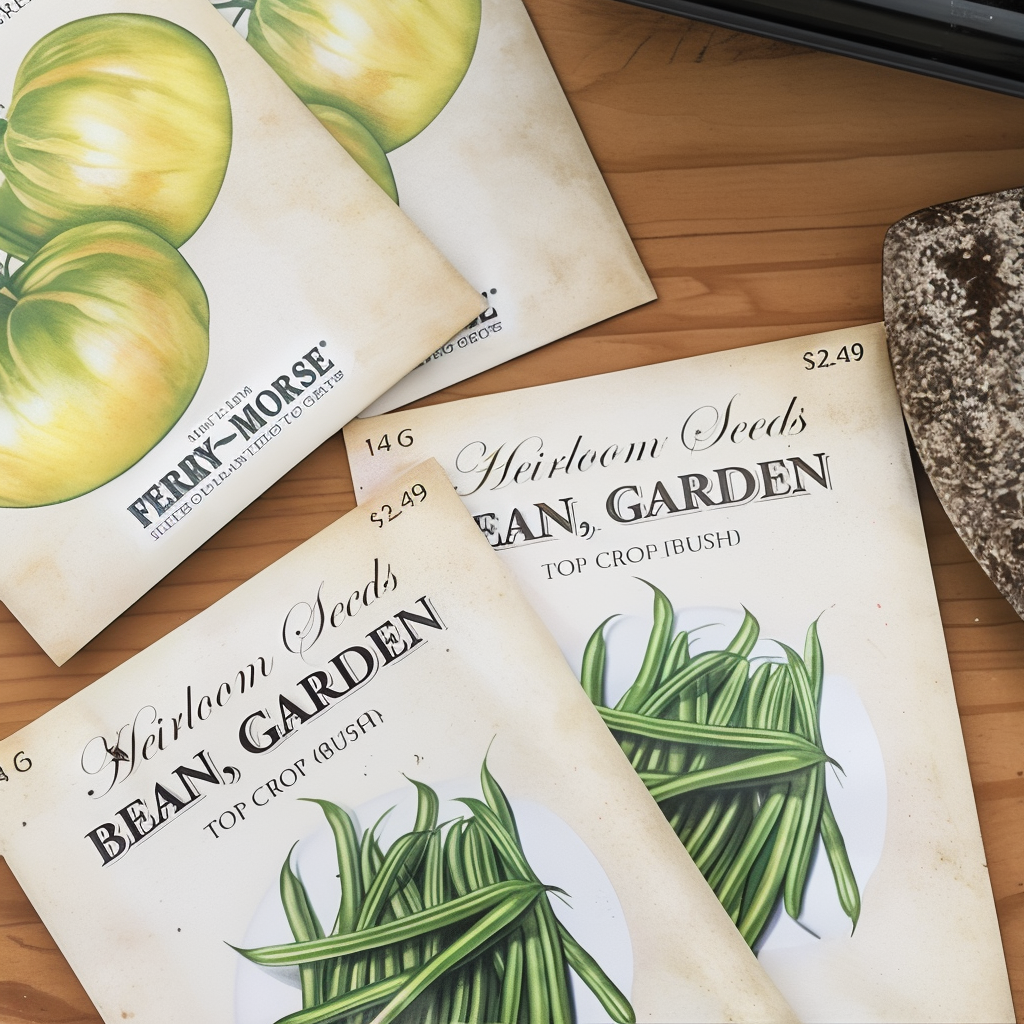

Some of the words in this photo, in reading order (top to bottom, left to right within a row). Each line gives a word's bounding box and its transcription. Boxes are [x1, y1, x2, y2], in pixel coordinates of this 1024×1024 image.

[453, 435, 668, 497] Heirloom
[681, 393, 807, 453] Seeds
[606, 452, 833, 524] GARDEN
[541, 557, 588, 580] TOP
[596, 544, 659, 570] CROP
[84, 749, 242, 868] BEAN,
[238, 595, 448, 755] GARDEN
[203, 802, 247, 839] TOP
[251, 758, 306, 807] CROP
